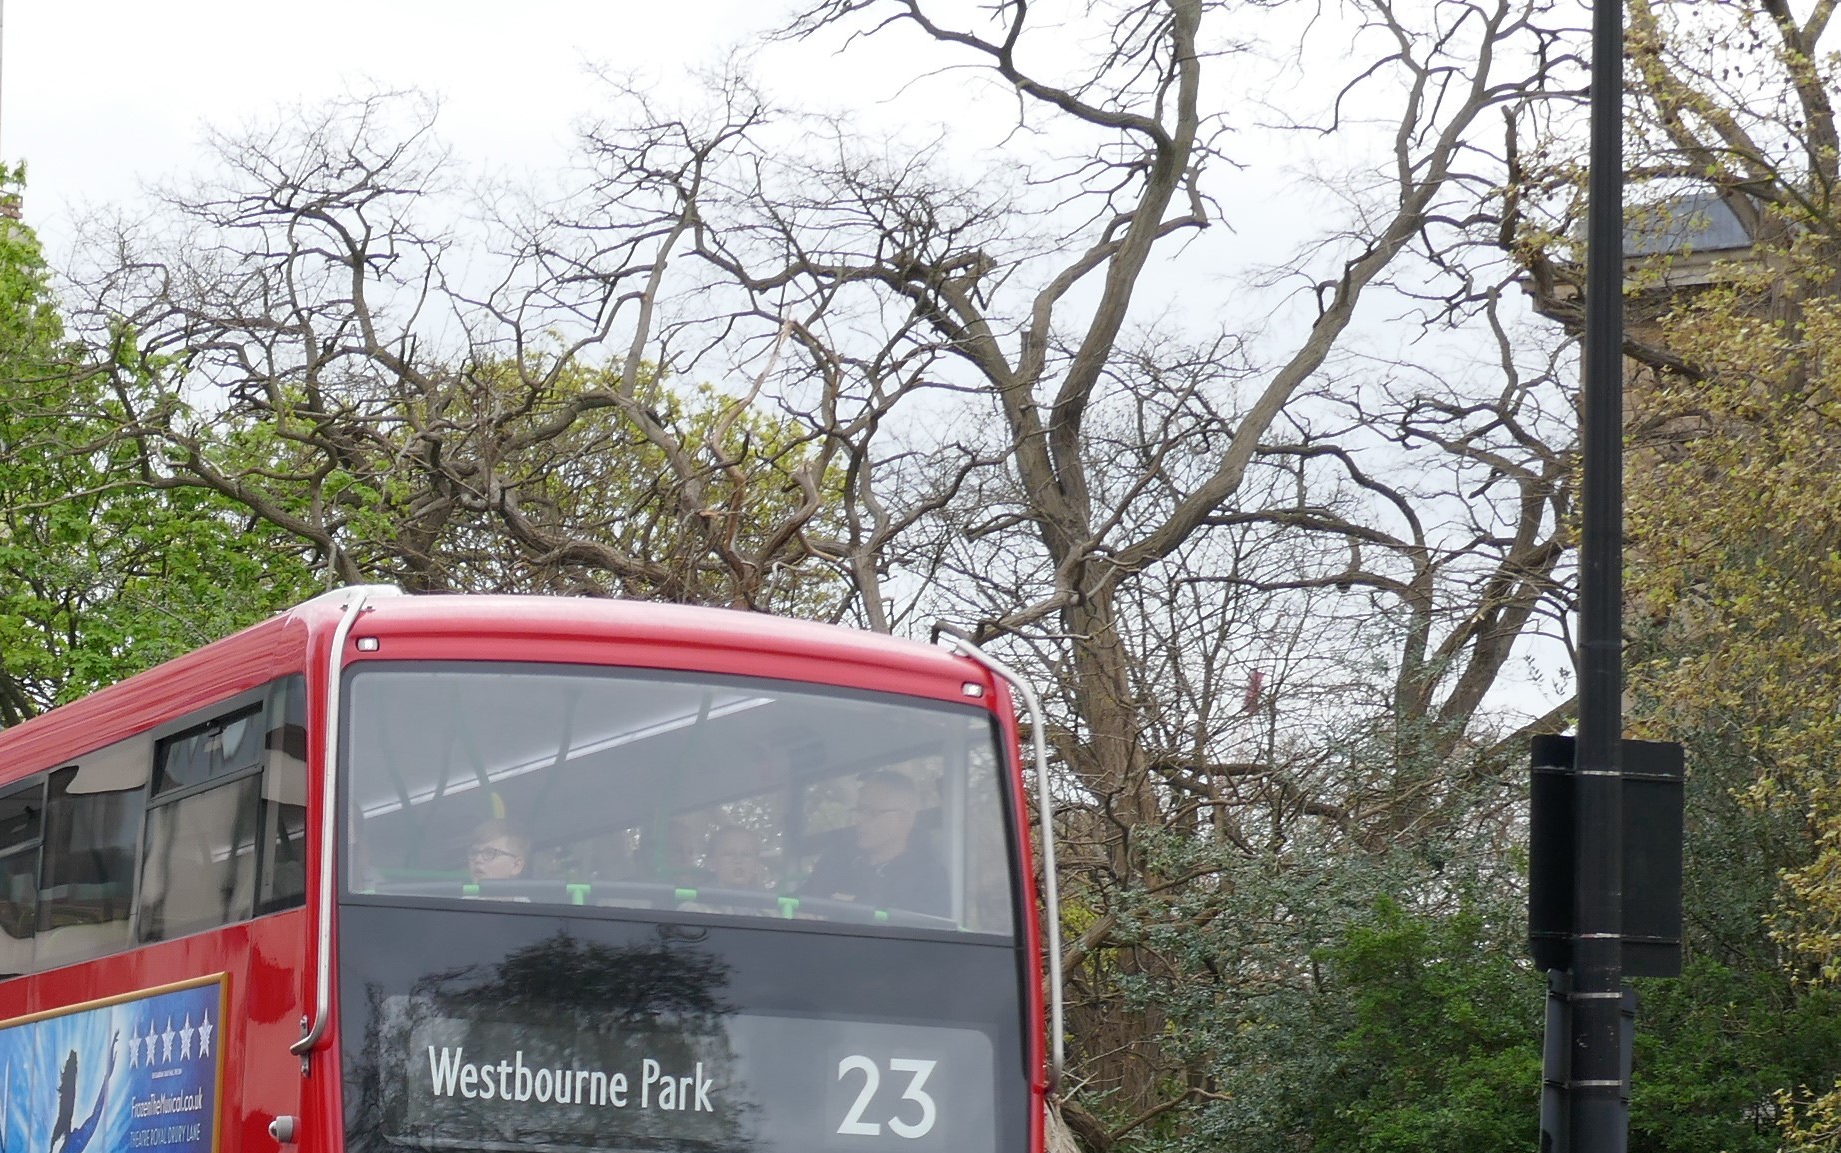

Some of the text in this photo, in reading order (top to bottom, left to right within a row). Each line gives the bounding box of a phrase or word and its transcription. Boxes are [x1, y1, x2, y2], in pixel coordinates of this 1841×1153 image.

[132, 1087, 203, 1118] FrozenTheMusical.co.uk
[427, 1045, 714, 1112] Westbourne Park
[836, 1054, 938, 1138] 23
